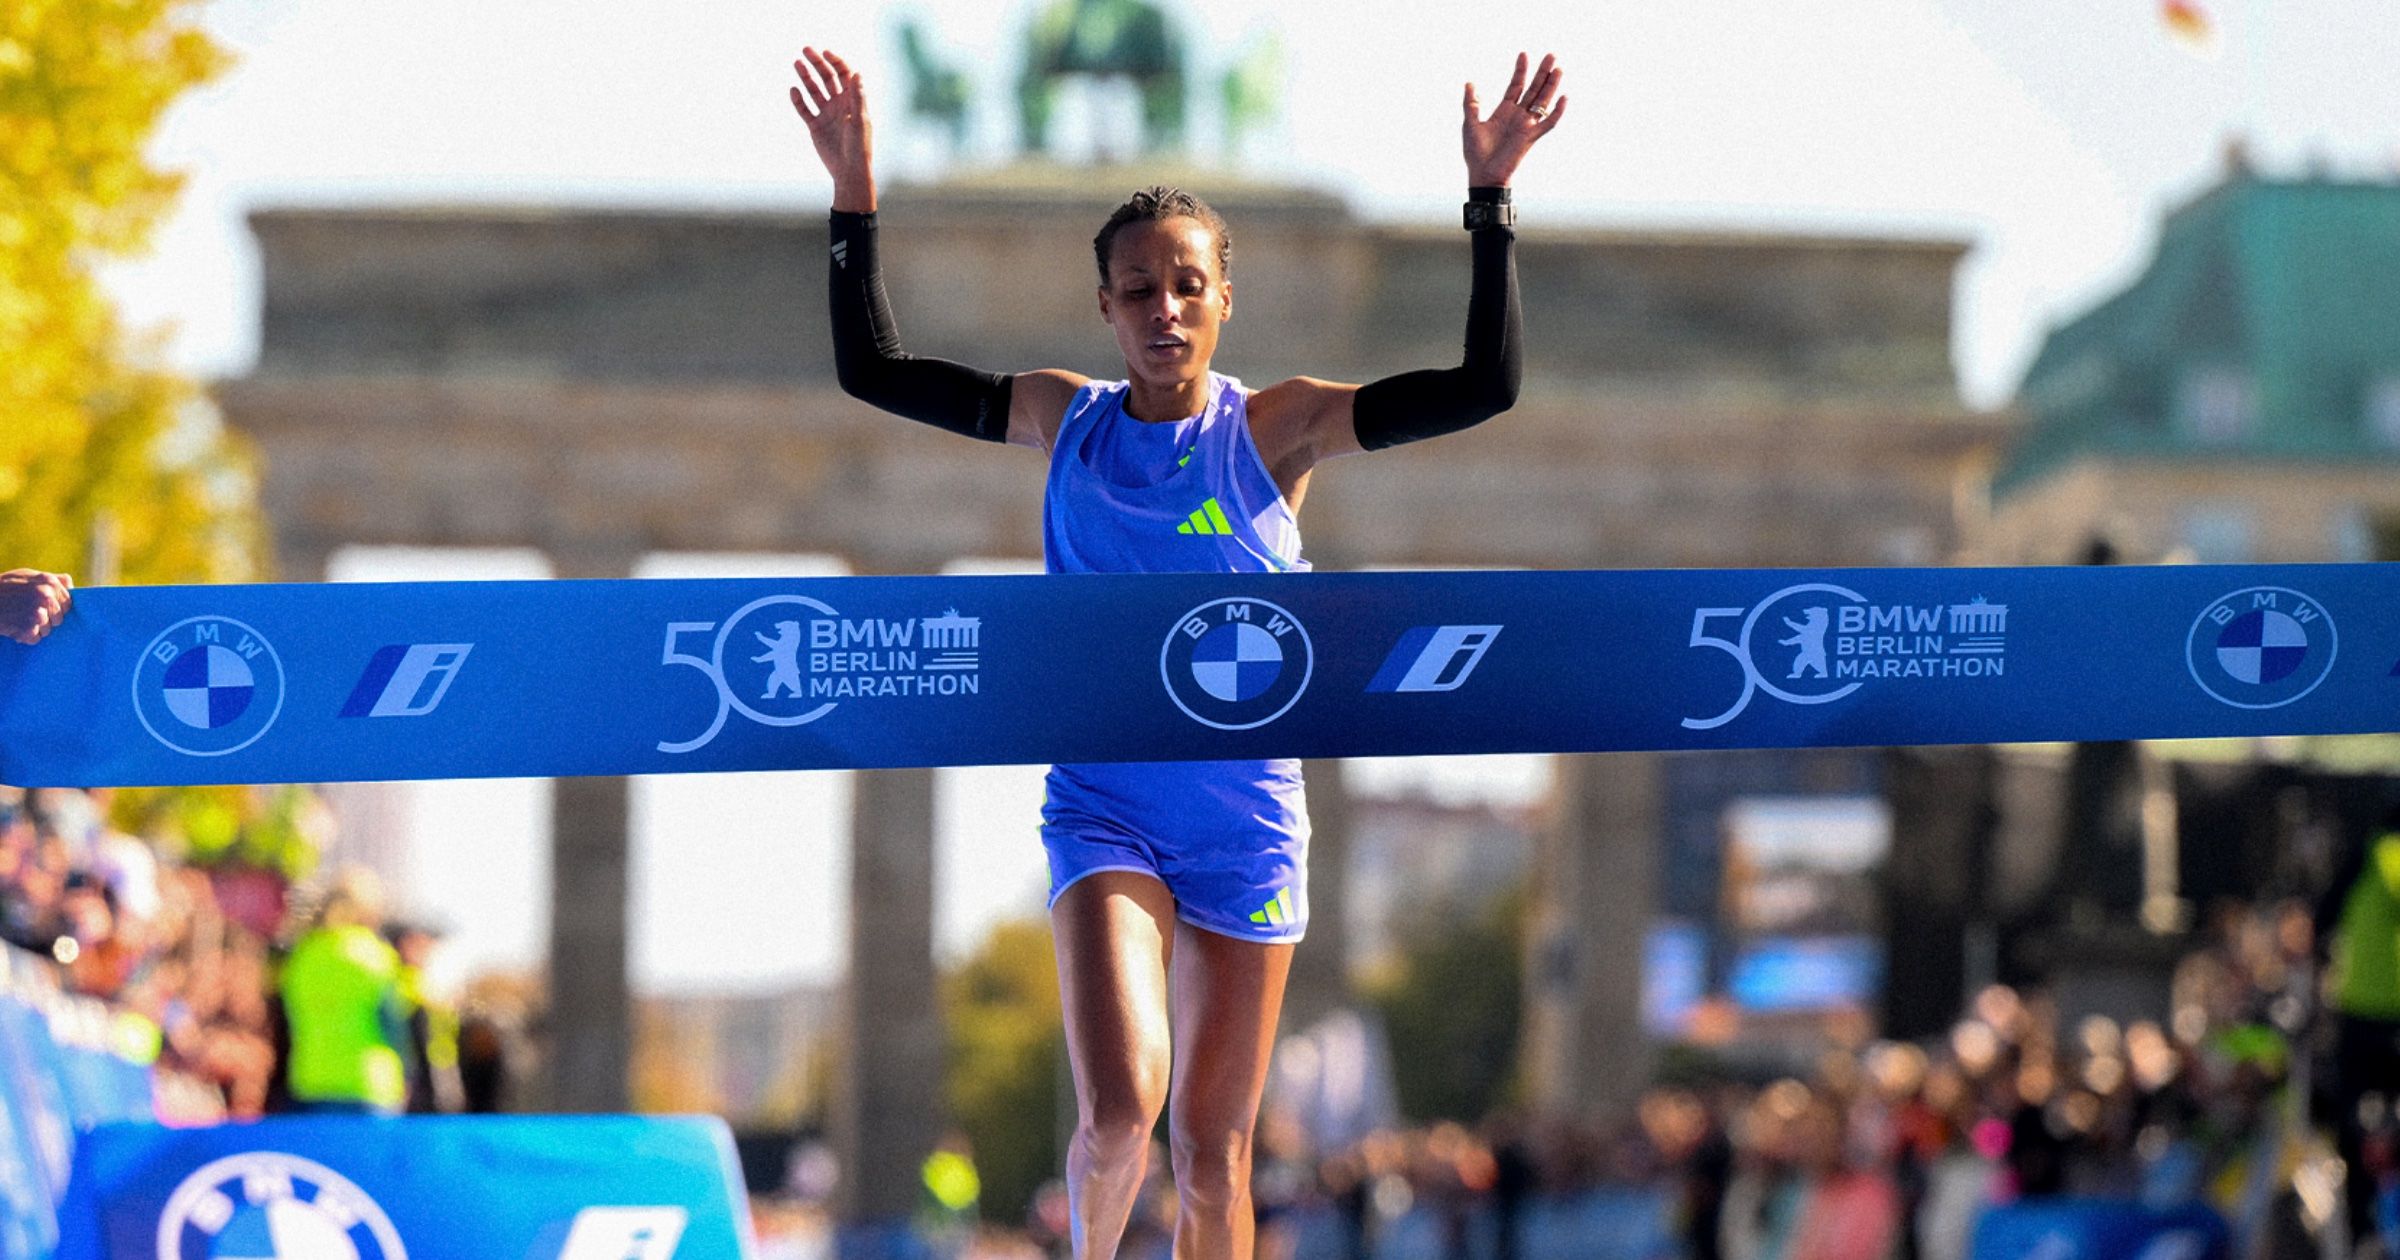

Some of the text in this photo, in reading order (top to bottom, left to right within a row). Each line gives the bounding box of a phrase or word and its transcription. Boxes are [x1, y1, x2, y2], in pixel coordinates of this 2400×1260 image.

[1182, 604, 1294, 640] BMW
[1838, 604, 1943, 634] BMW
[2209, 592, 2319, 626] BMW
[153, 623, 264, 664] BMW
[810, 618, 916, 649] BMW
[1836, 635, 1943, 656] BERLIN
[810, 651, 917, 673] BERLIN
[1681, 583, 1868, 729] 50
[1836, 658, 2005, 678] MARATHON
[656, 594, 840, 754] 50
[810, 674, 979, 698] MARATHON
